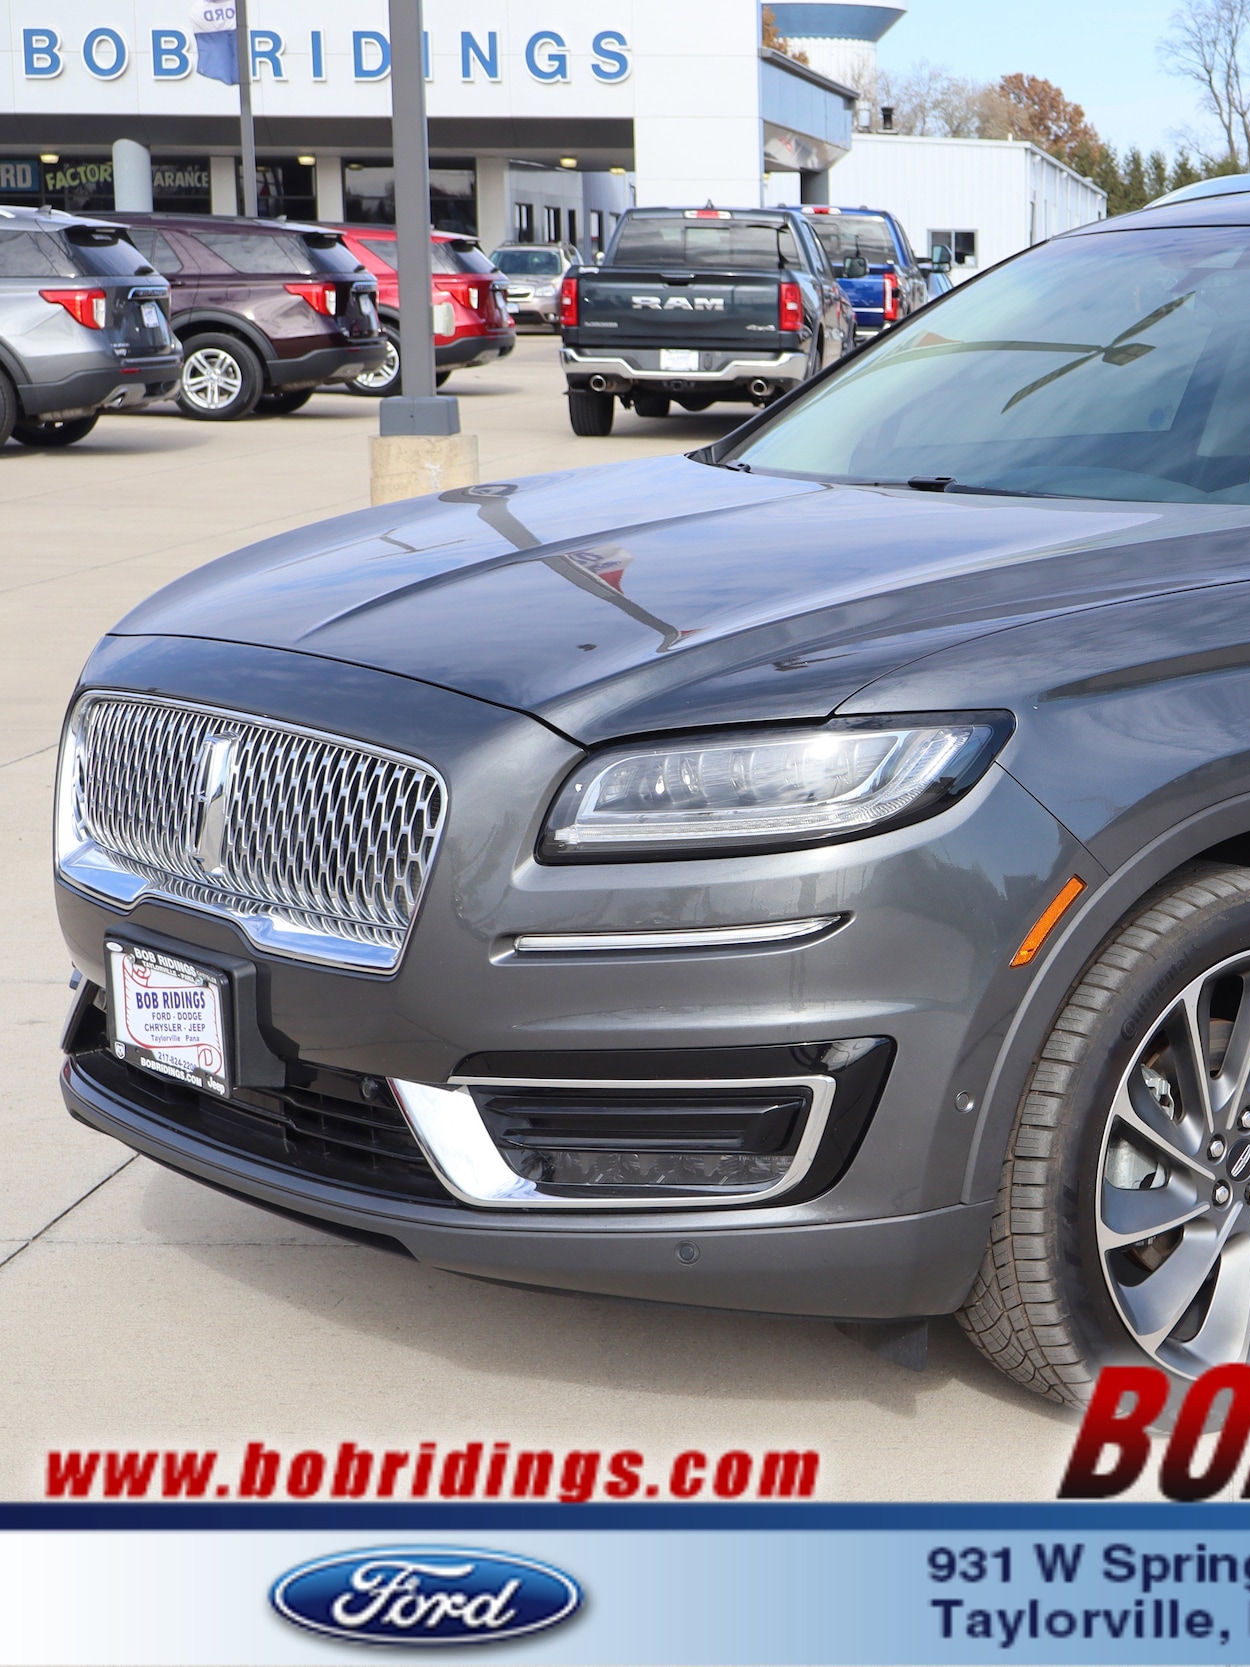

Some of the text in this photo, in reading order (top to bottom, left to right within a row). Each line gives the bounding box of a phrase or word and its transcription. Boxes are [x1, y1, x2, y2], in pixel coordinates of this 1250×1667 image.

[22, 26, 632, 82] BOB RIDINGS
[45, 163, 113, 191] FACTOR
[153, 171, 209, 188] ARANCE
[631, 296, 725, 311] RAM
[133, 947, 197, 978] BOB RIDINGS
[135, 991, 206, 1010] BOB RIDINGS
[152, 1011, 171, 1021] FORD
[177, 1011, 203, 1021] DODGE
[144, 1023, 183, 1032] CHRYSLER
[188, 1023, 206, 1032] JEEP
[150, 1034, 200, 1043] Taylorville Pana
[140, 1056, 203, 1088] BOBRIDINGS.COM
[207, 1076, 226, 1096] Jeep
